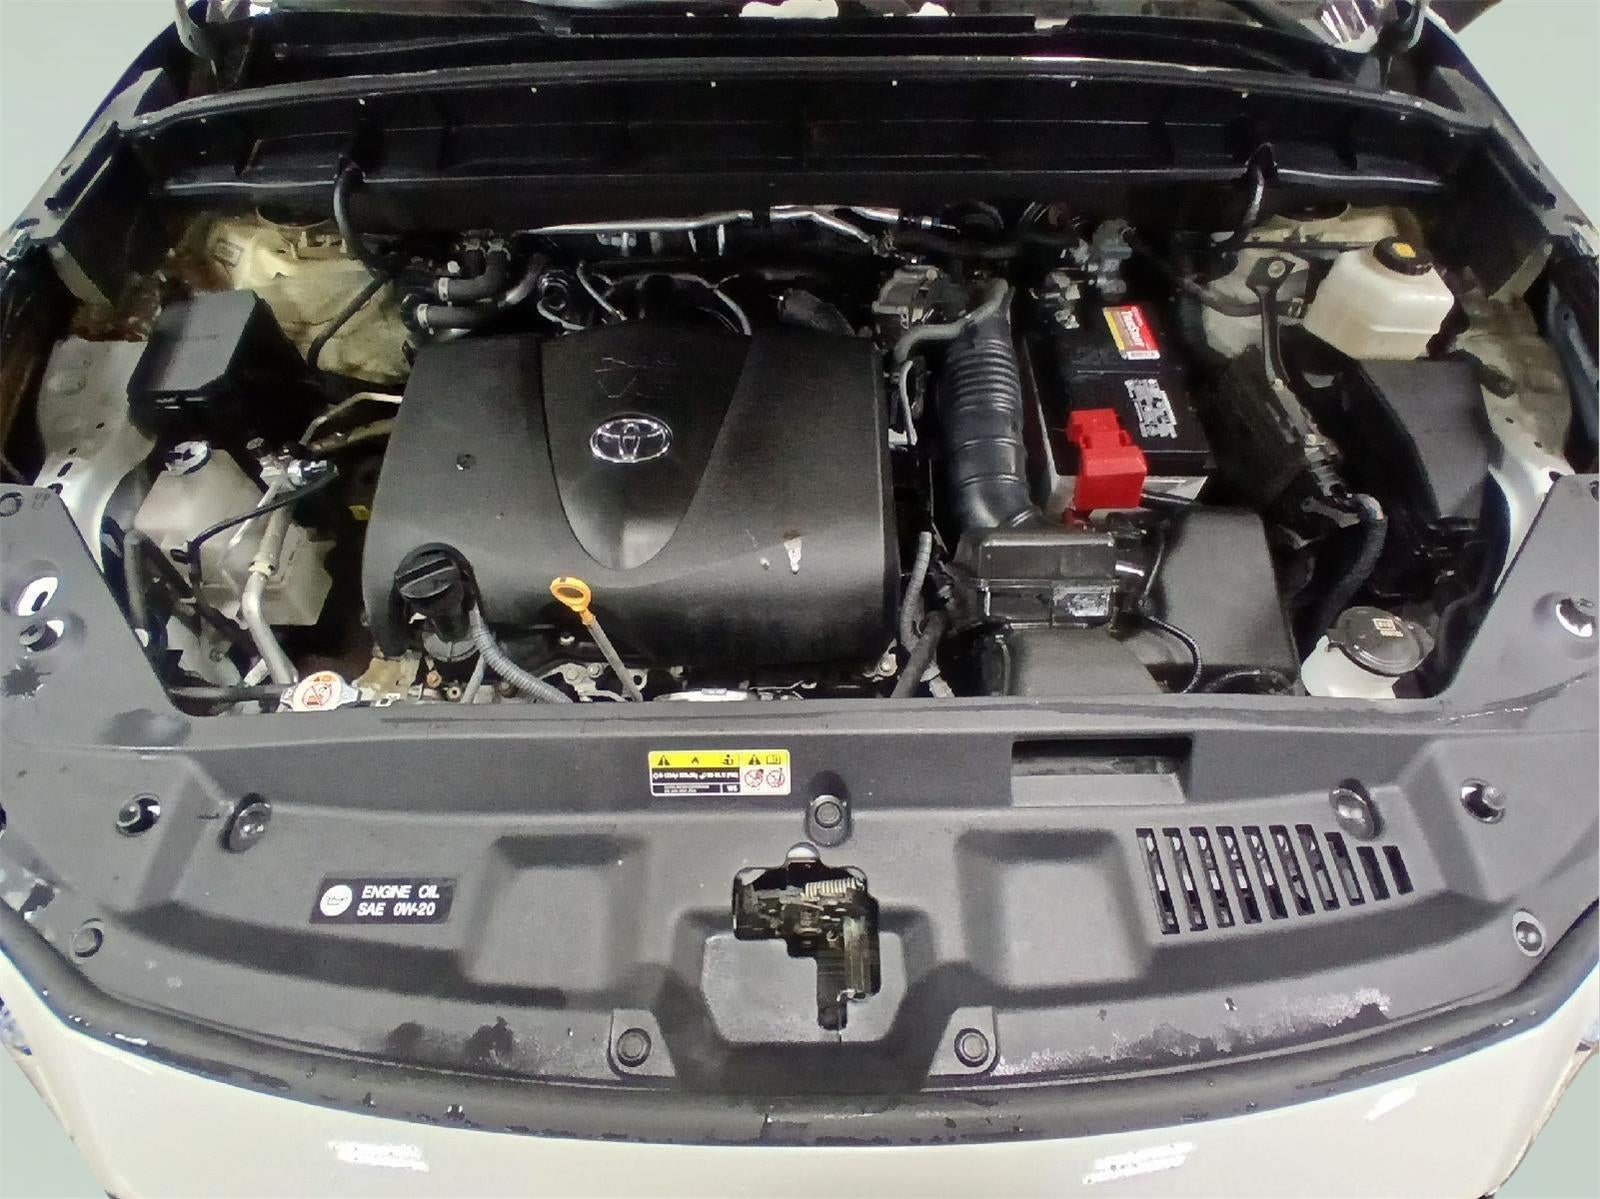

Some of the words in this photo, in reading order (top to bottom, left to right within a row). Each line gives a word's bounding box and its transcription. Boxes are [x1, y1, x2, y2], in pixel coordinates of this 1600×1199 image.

[361, 884, 412, 899] ENGINE
[418, 884, 440, 899] OIL
[356, 902, 386, 917] SAE
[393, 902, 436, 917] 0W-20
